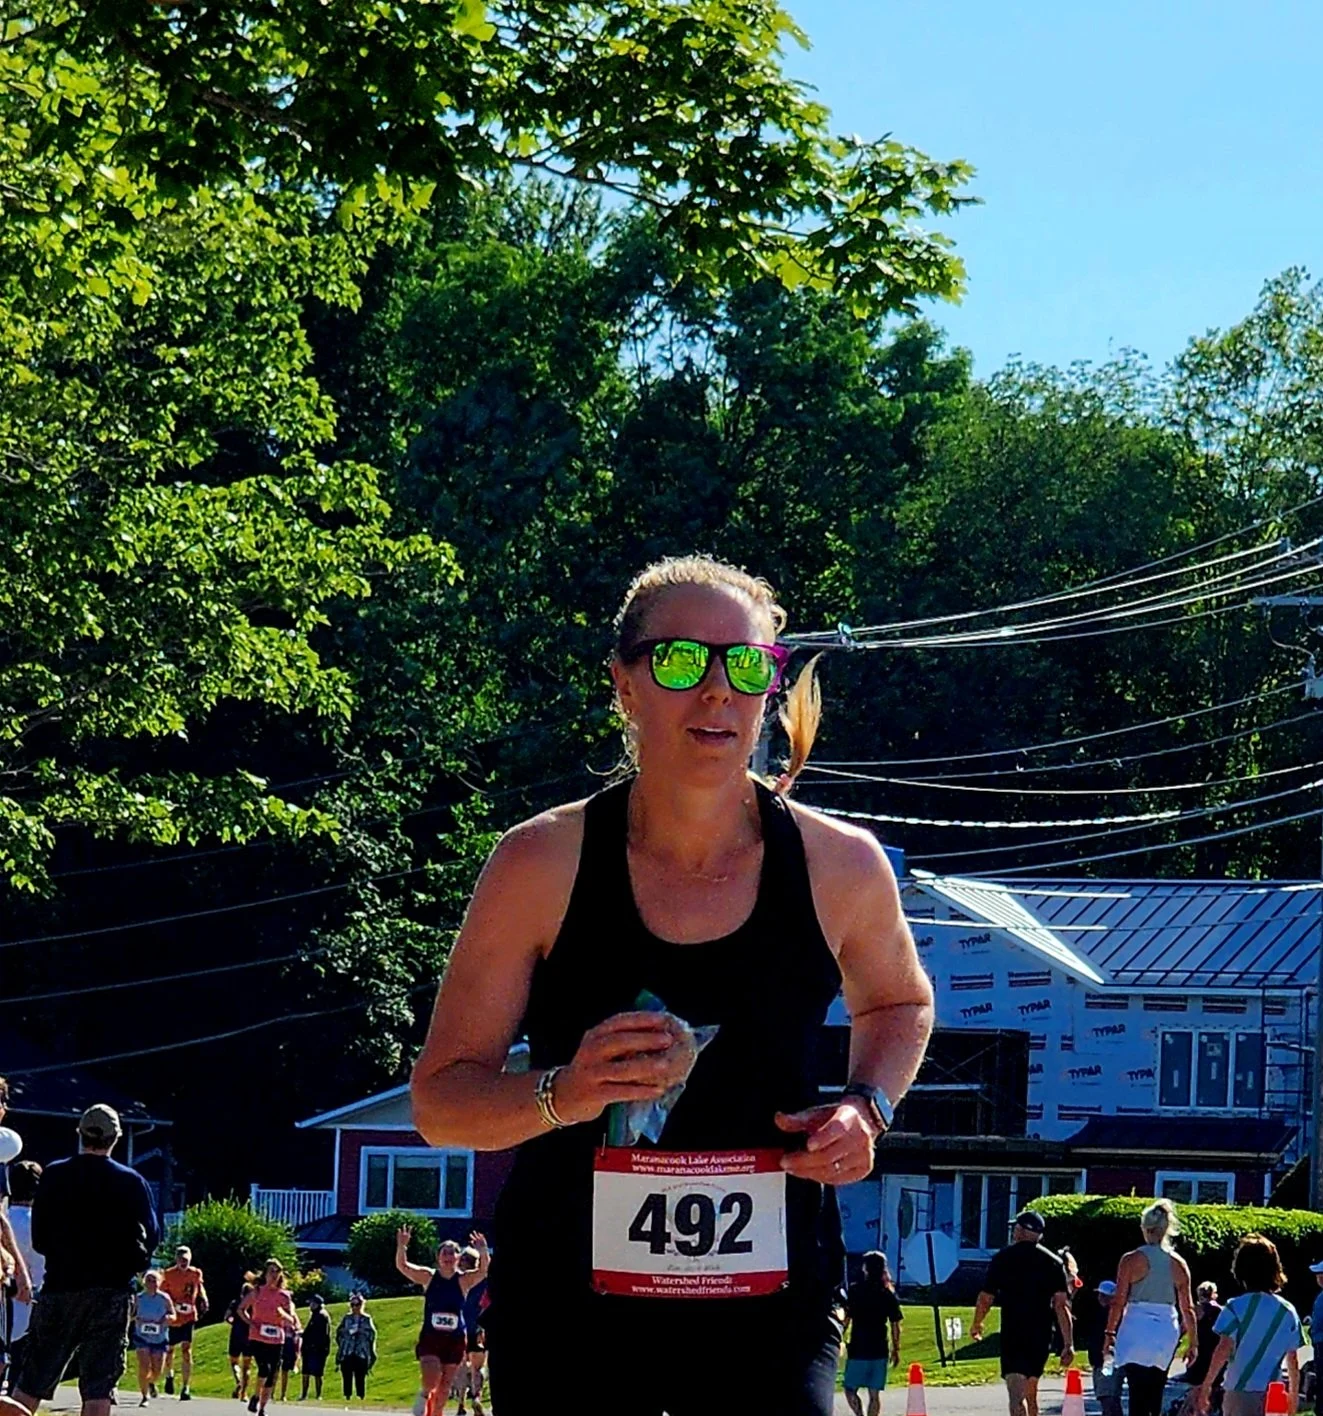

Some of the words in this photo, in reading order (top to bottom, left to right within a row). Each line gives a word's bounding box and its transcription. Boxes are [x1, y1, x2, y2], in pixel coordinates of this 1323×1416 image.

[958, 932, 991, 949] TYPAR
[960, 1002, 993, 1019] TYPAR
[1018, 999, 1051, 1016] TYPAR
[1092, 1024, 1126, 1038] TYPAR
[1068, 1065, 1103, 1080] TYPAR
[631, 1153, 687, 1165] Maranacook
[688, 1155, 708, 1165] Lake
[710, 1153, 756, 1164] Association
[628, 1191, 753, 1257] 492
[652, 1275, 700, 1285] Watershed
[701, 1275, 733, 1285] Friends
[631, 1285, 751, 1295] www.watershedfriends.com
